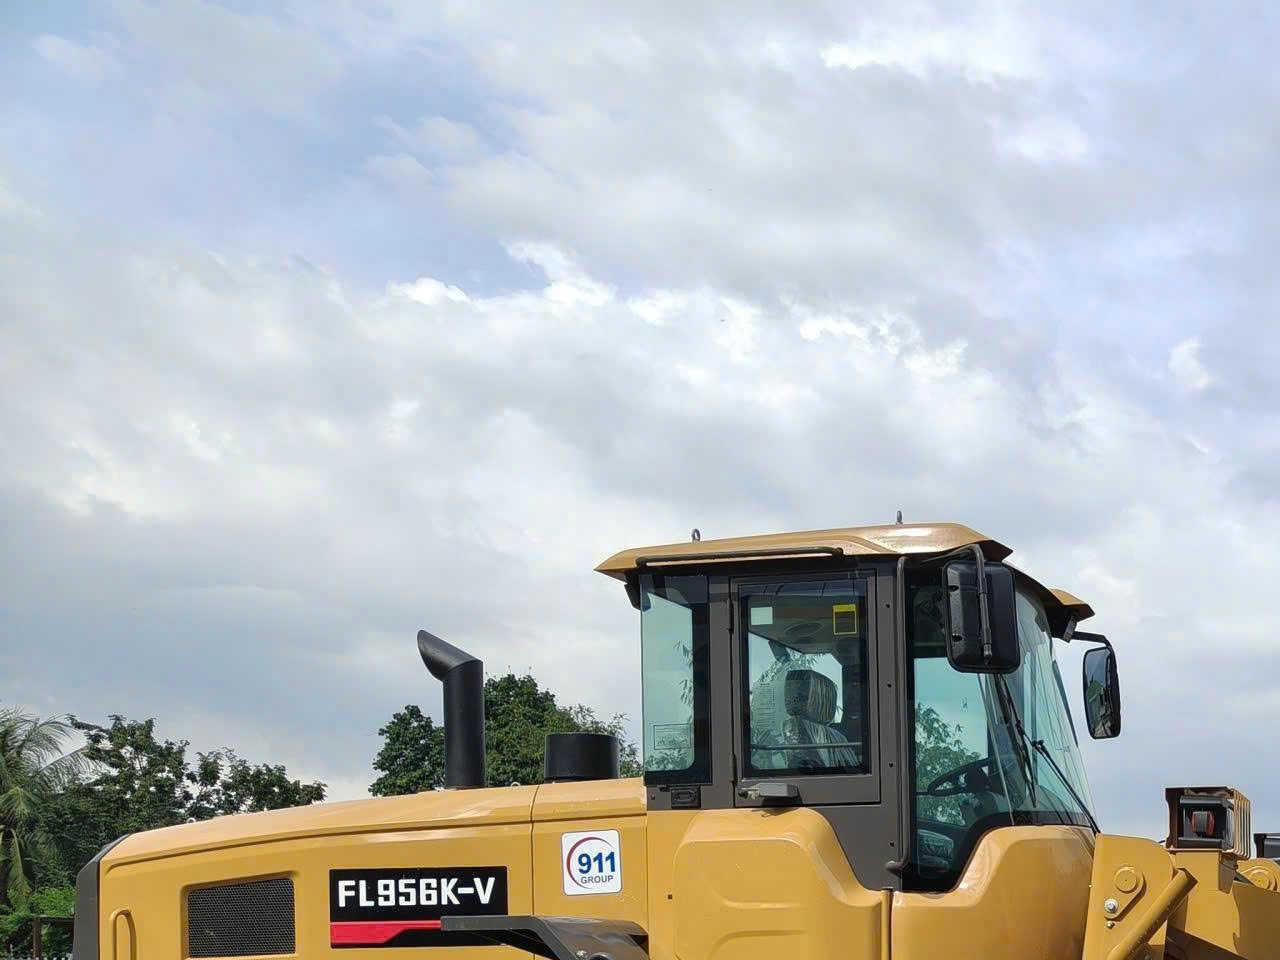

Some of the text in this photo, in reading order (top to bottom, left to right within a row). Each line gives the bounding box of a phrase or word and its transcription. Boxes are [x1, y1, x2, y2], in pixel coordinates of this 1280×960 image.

[578, 851, 616, 875] 911
[580, 874, 614, 885] GROUP
[338, 876, 496, 908] FL956K-V
